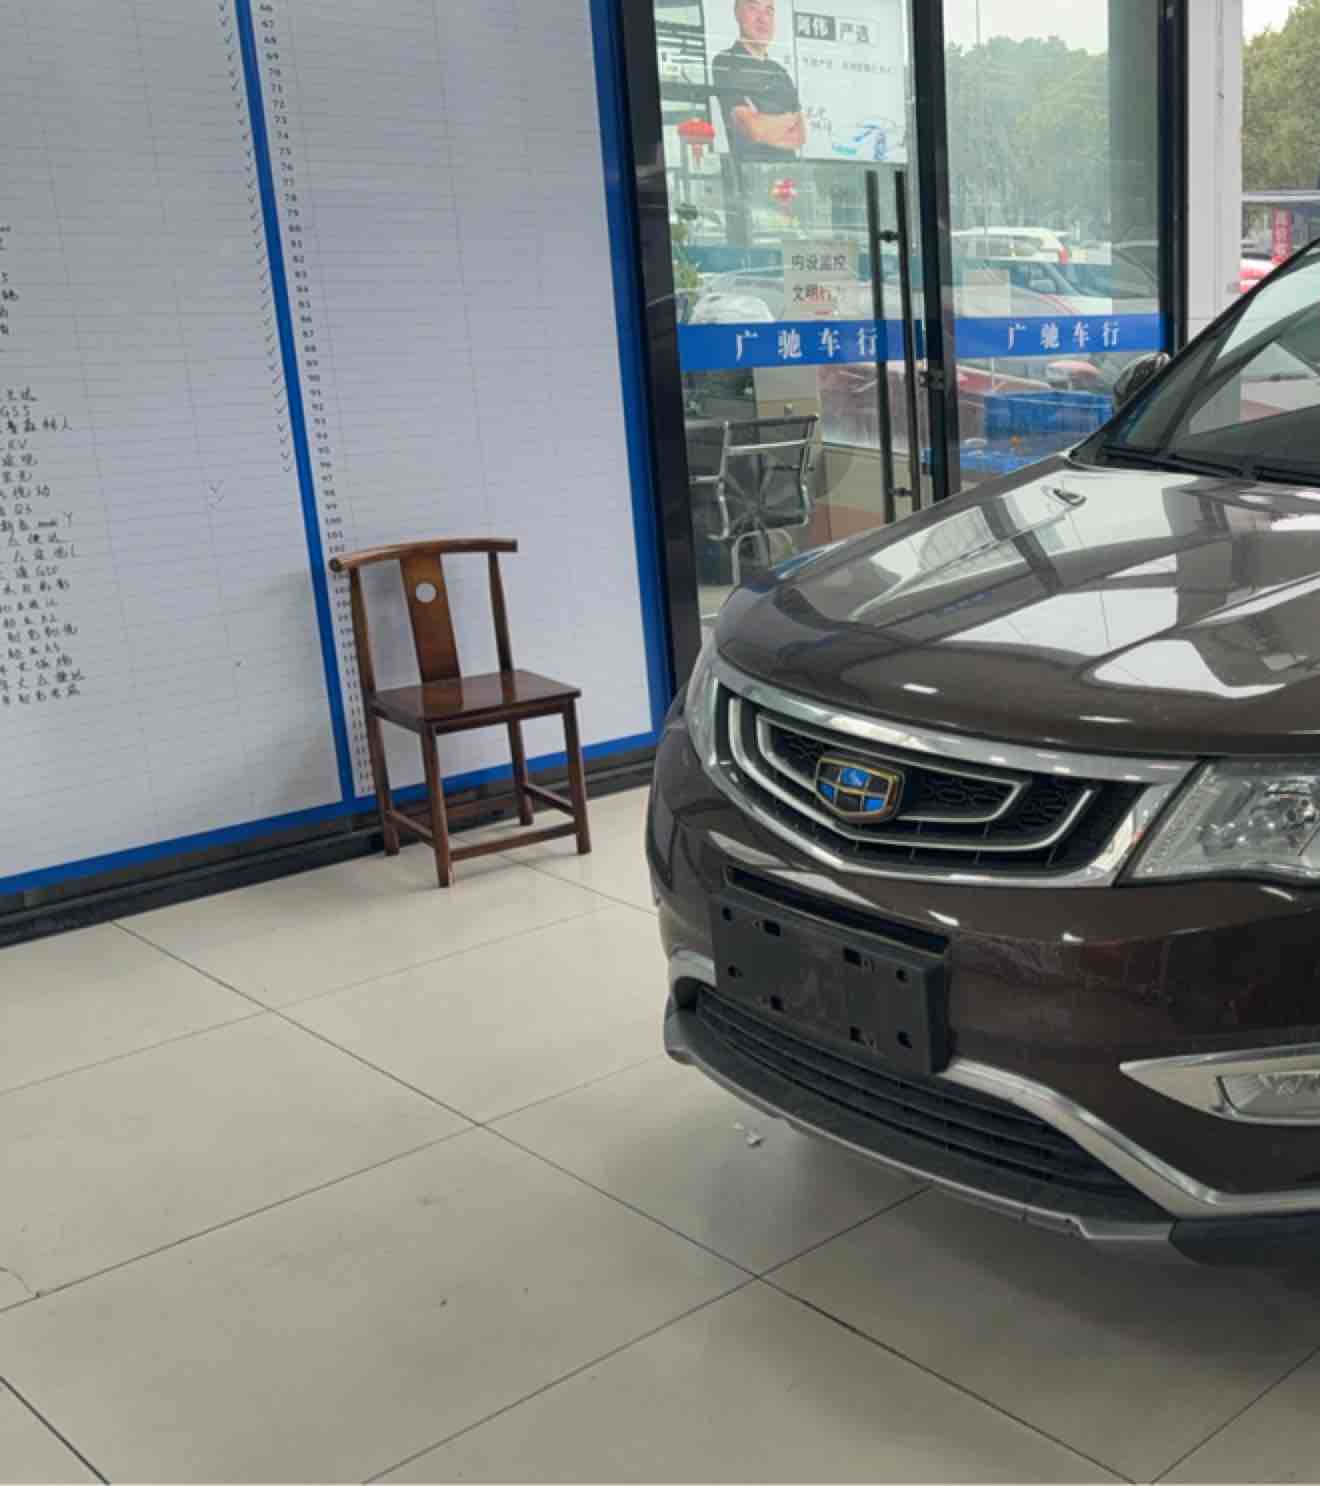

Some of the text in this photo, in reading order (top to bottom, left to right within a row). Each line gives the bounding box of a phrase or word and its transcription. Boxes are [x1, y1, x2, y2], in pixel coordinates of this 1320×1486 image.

[733, 326, 880, 362] 广驰车行
[1006, 320, 1121, 350] 广驰车行
